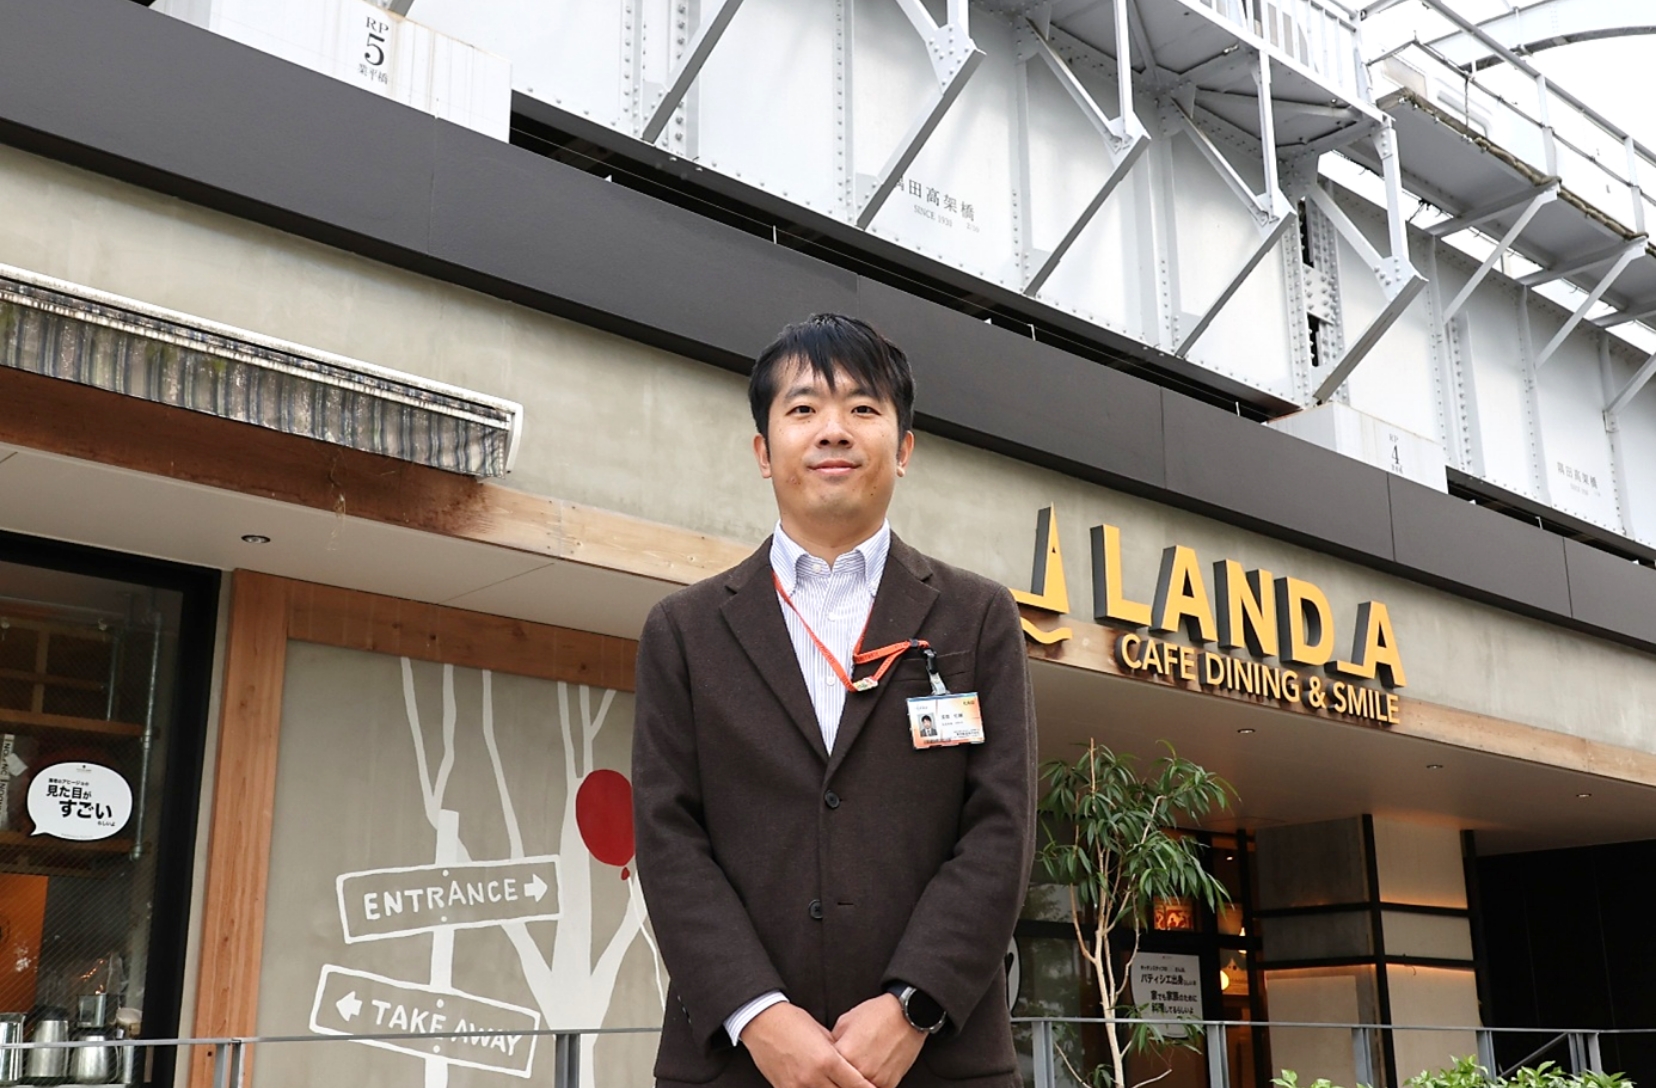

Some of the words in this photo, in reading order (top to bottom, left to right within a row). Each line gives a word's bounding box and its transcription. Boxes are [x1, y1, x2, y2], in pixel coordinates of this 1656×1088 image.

[366, 15, 389, 33] RP
[364, 32, 385, 66] 5
[1391, 445, 1400, 465] 4
[1119, 633, 1196, 681] CAFE
[1205, 652, 1300, 703] DINING
[1308, 677, 1326, 709] &
[1331, 682, 1400, 725] SMILE
[46, 784, 92, 800] 見た目が
[59, 799, 112, 820] すごい
[363, 879, 519, 920] ENTRANCE
[372, 999, 447, 1040] TAKE
[451, 1018, 523, 1056] AWAY
